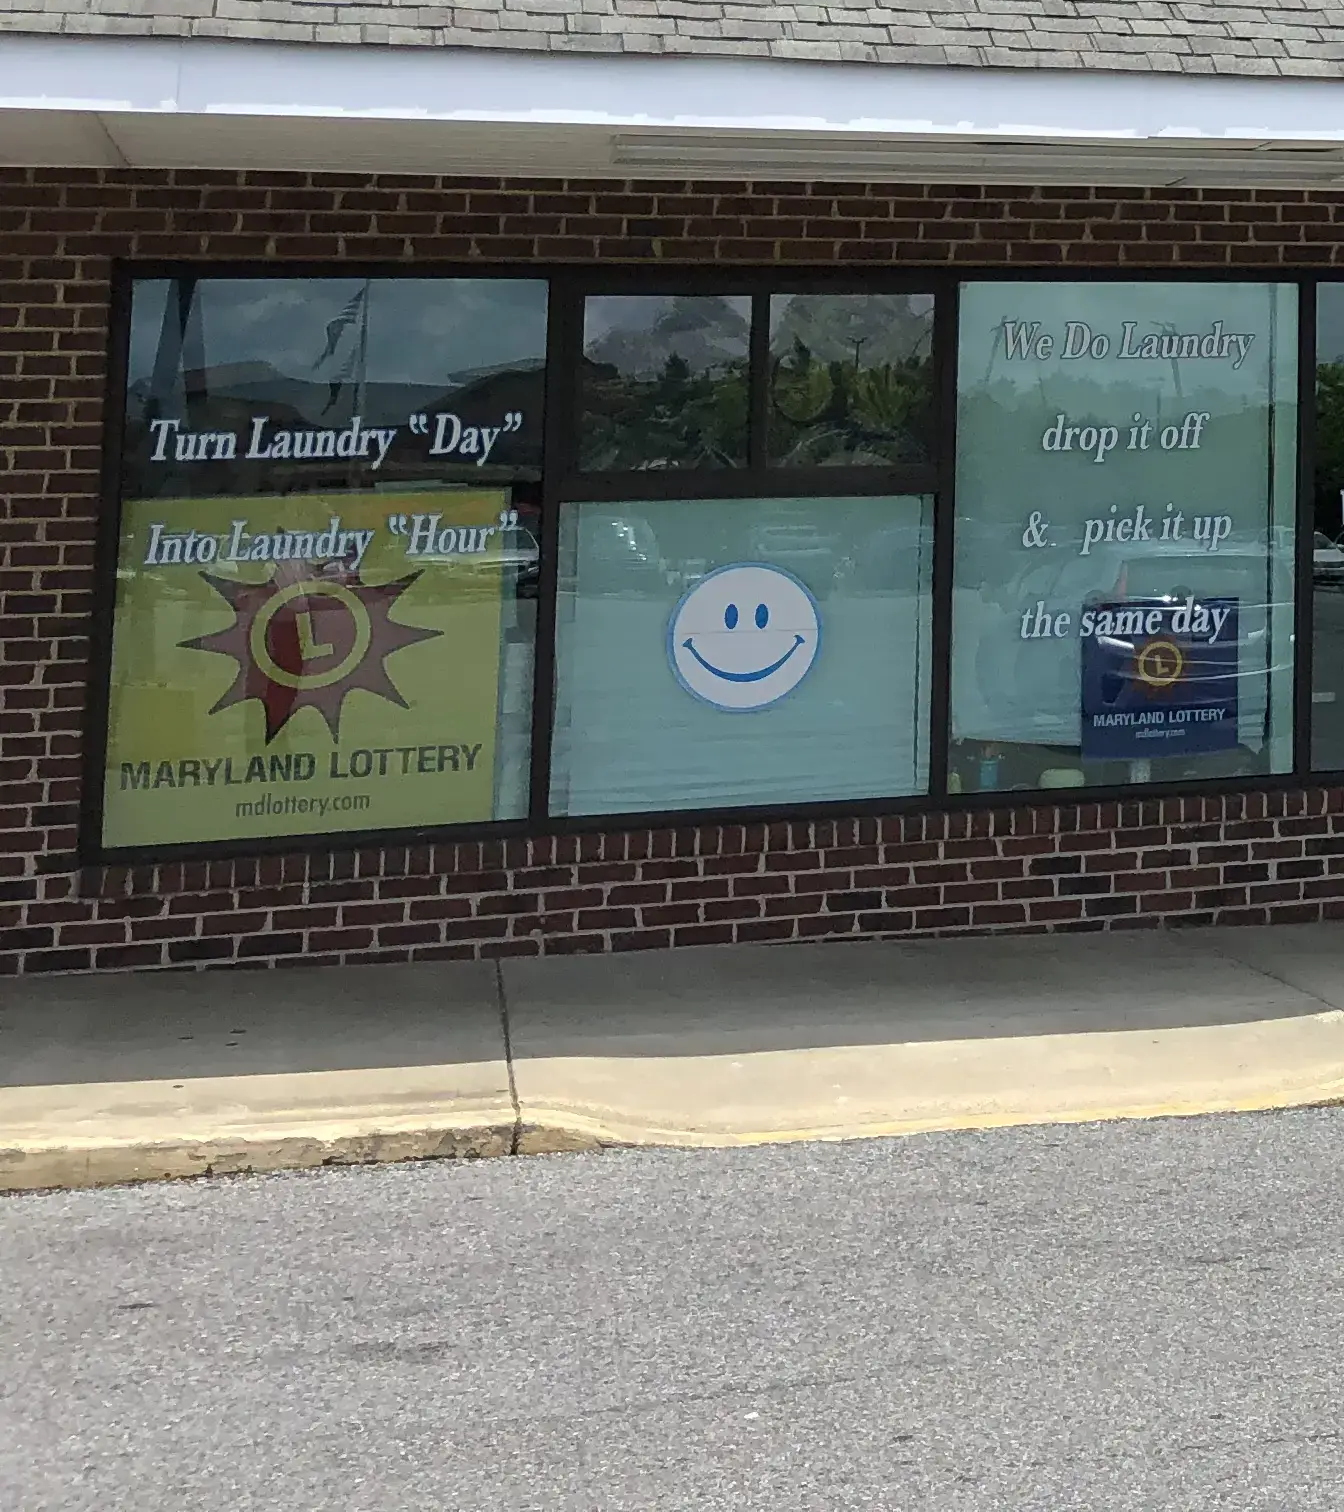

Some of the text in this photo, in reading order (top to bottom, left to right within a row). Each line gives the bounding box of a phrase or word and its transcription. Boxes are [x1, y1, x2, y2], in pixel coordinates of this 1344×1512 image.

[1003, 320, 1255, 370] We Do Laundry
[150, 418, 236, 461] Turn
[245, 416, 397, 469] Laundry
[1042, 411, 1211, 463] drop it off
[143, 523, 217, 565] Into
[226, 517, 375, 570] Laundry
[1079, 504, 1153, 556] pick
[1159, 502, 1184, 541] it
[1194, 514, 1232, 551] up
[296, 612, 333, 660] L
[1020, 595, 1231, 645] the same day
[1093, 708, 1226, 727] MARYLAND LOTTERY
[120, 743, 483, 790] MARYLAND LOTTERY
[235, 792, 371, 818] mdlottery.com
